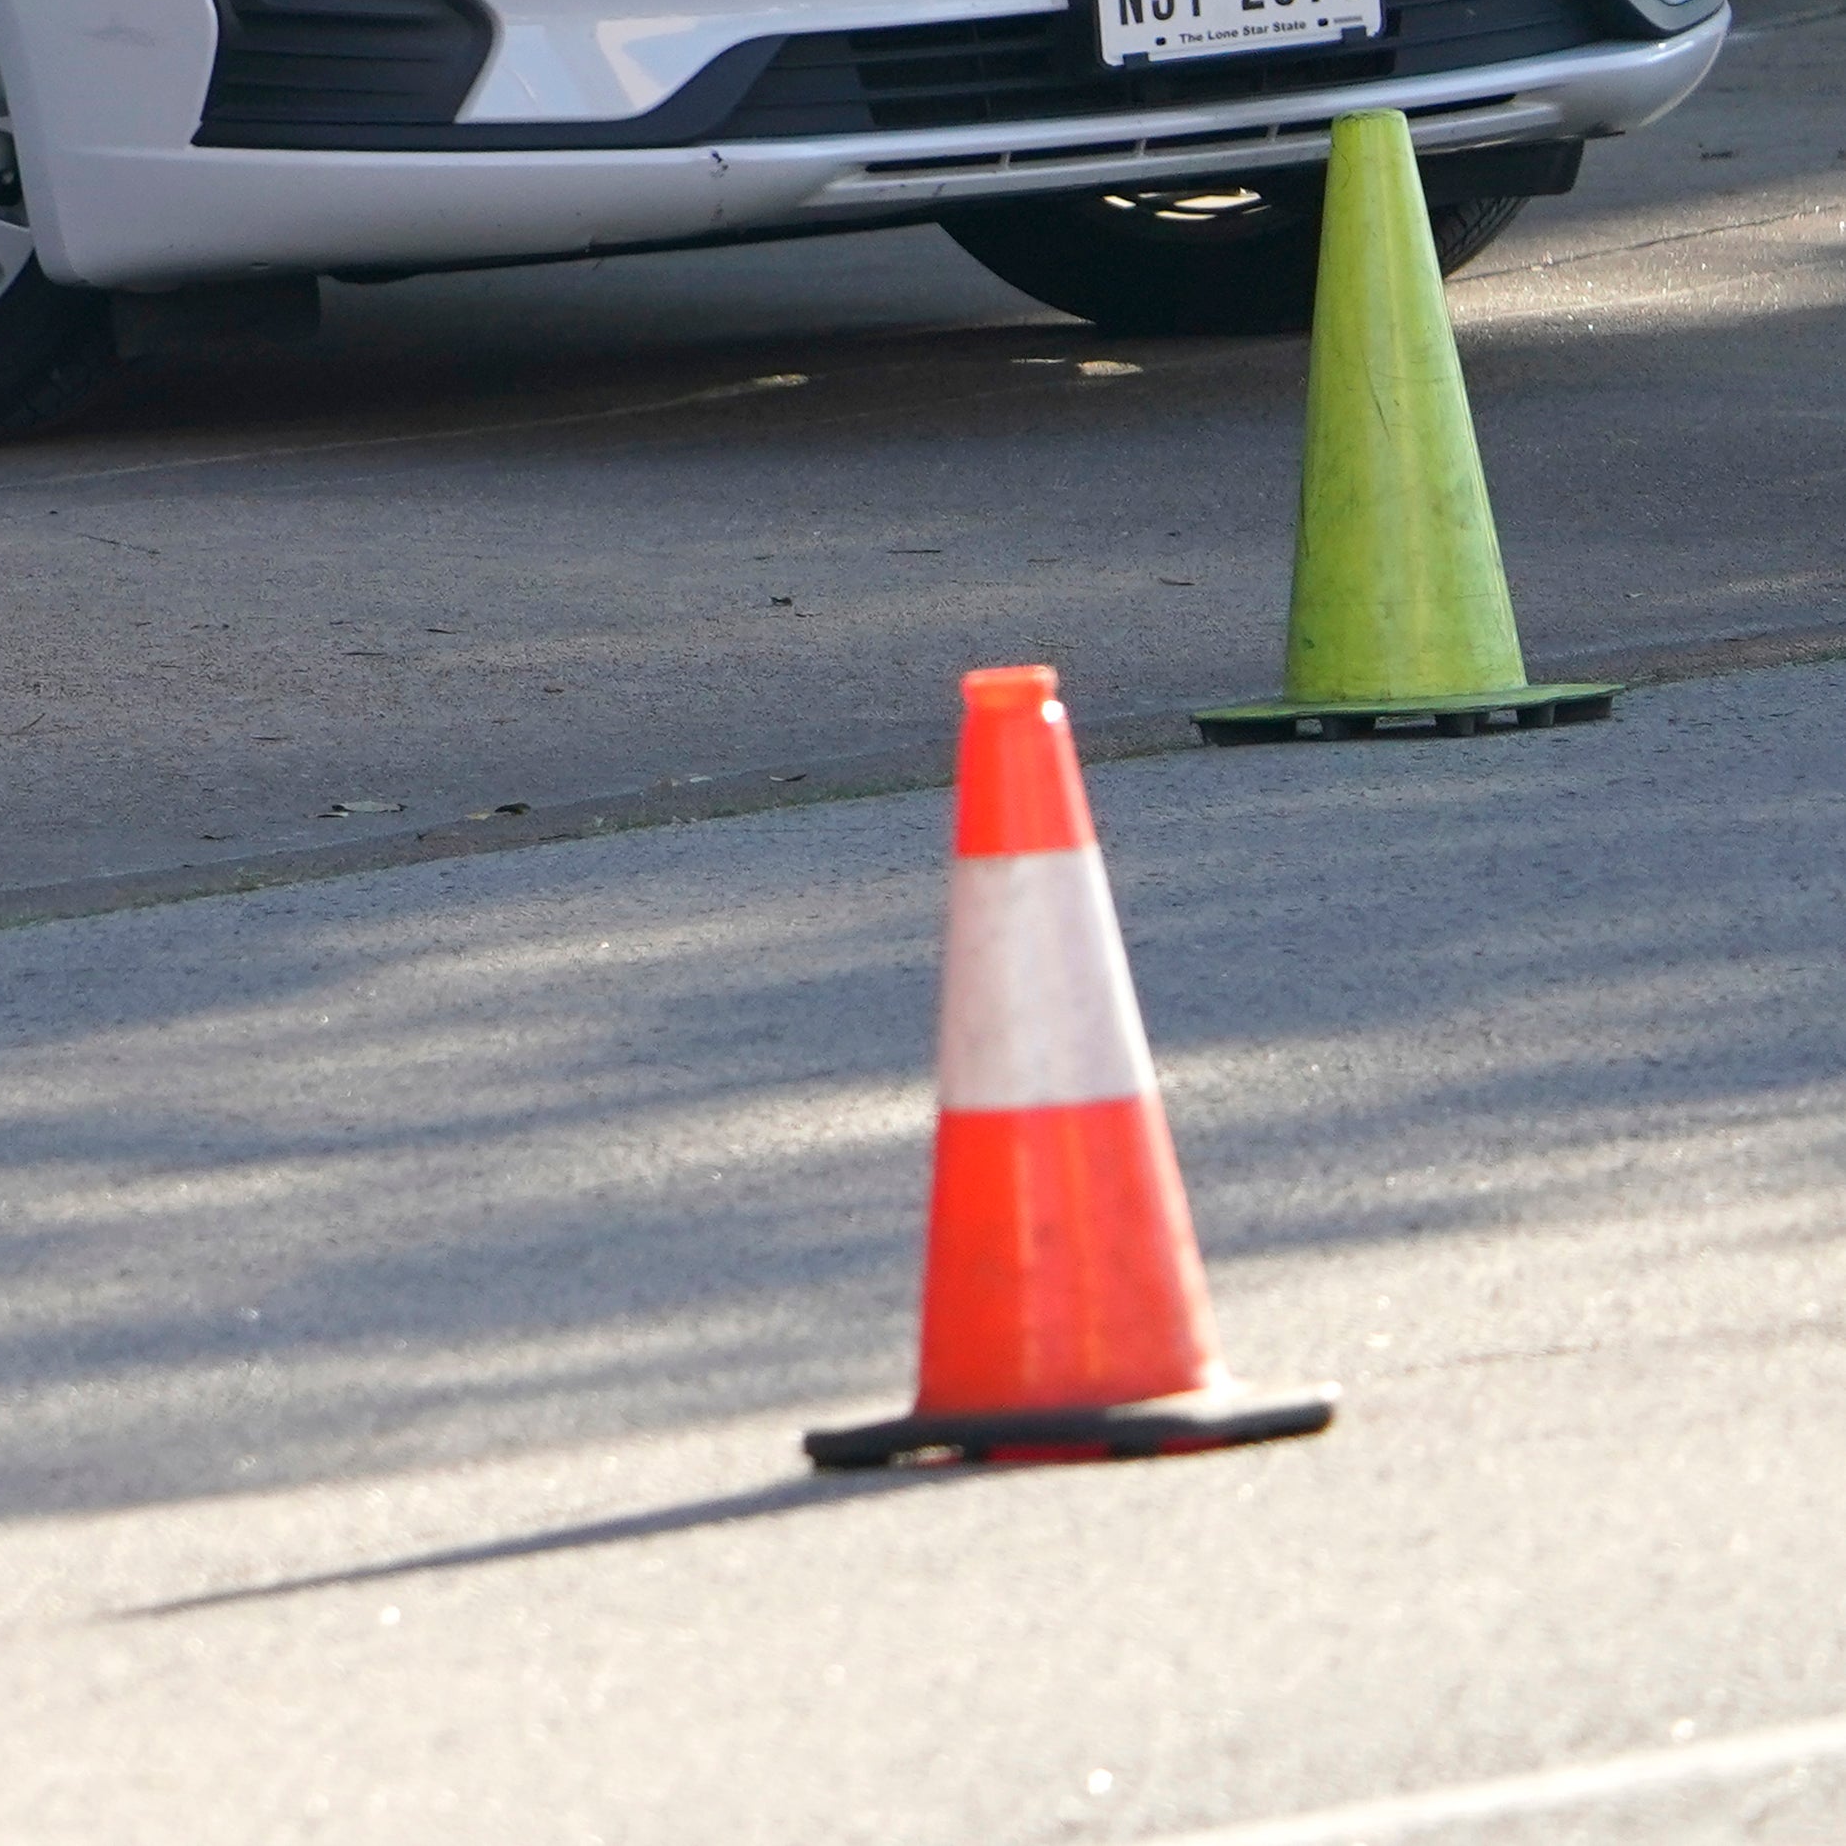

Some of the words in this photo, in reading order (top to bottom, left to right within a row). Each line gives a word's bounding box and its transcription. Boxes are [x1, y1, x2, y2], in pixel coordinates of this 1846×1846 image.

[1178, 32, 1205, 45] The
[1207, 28, 1239, 41] Lone
[1243, 24, 1269, 36] Star
[1273, 19, 1306, 32] State
